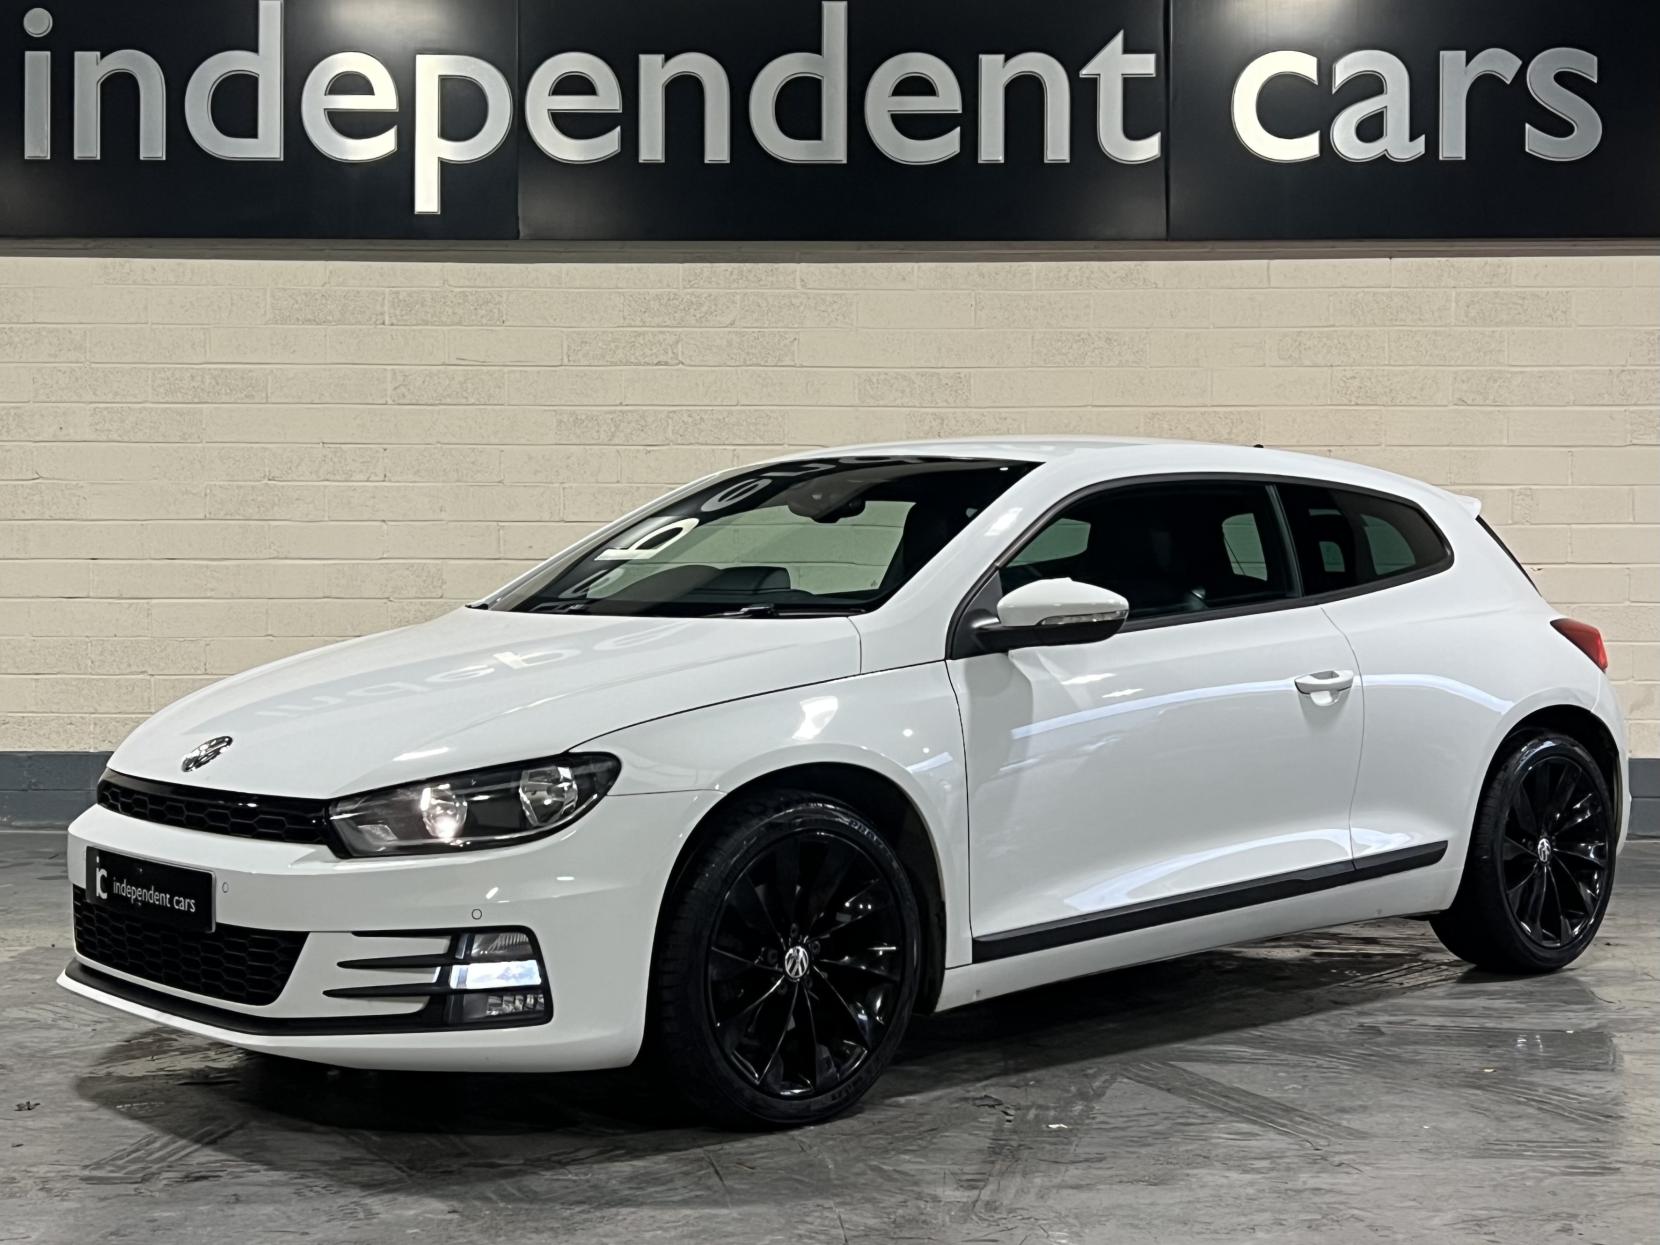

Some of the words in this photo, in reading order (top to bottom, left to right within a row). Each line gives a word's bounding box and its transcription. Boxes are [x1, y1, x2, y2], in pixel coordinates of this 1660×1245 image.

[22, 0, 1163, 215] independent
[1230, 46, 1603, 164] cars
[112, 876, 171, 907] independent
[173, 896, 197, 913] cars
